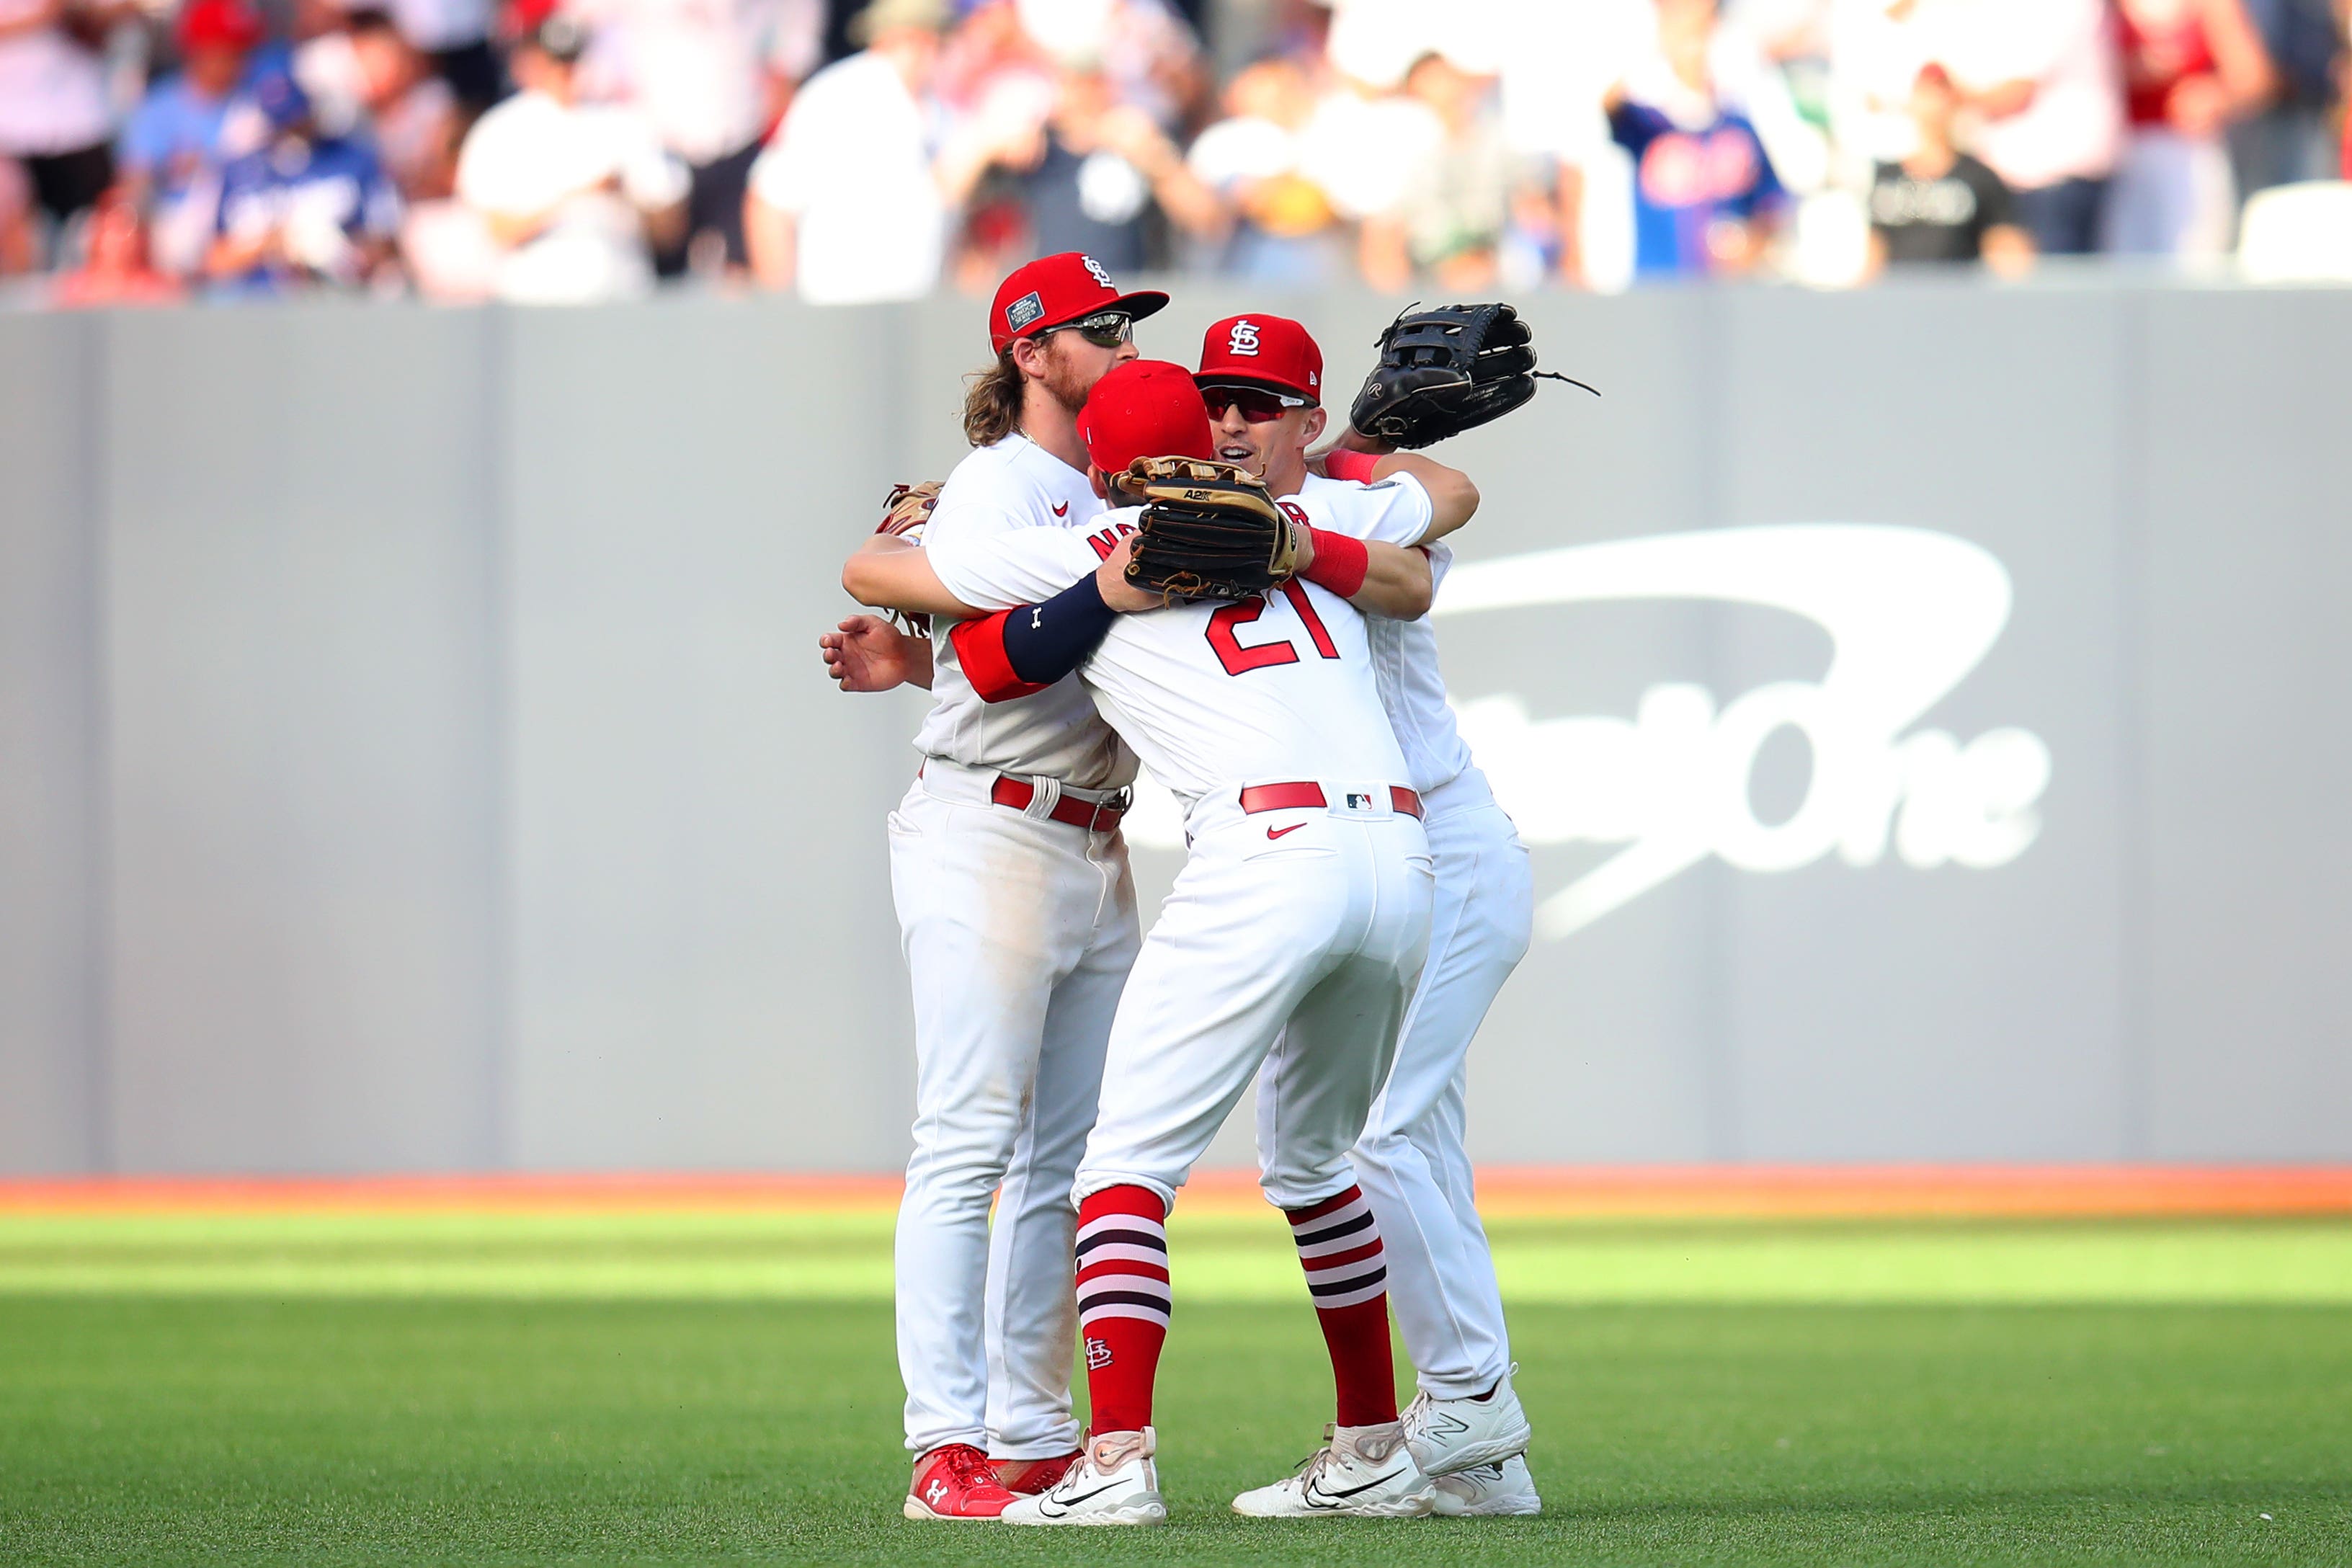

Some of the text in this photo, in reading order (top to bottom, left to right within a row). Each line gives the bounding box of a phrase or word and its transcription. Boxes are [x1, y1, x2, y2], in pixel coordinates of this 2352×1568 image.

[1011, 301, 1037, 321] LONDON
[1015, 310, 1036, 324] SERIES
[1183, 489, 1212, 502] A2K
[1204, 575, 1341, 677] 21
